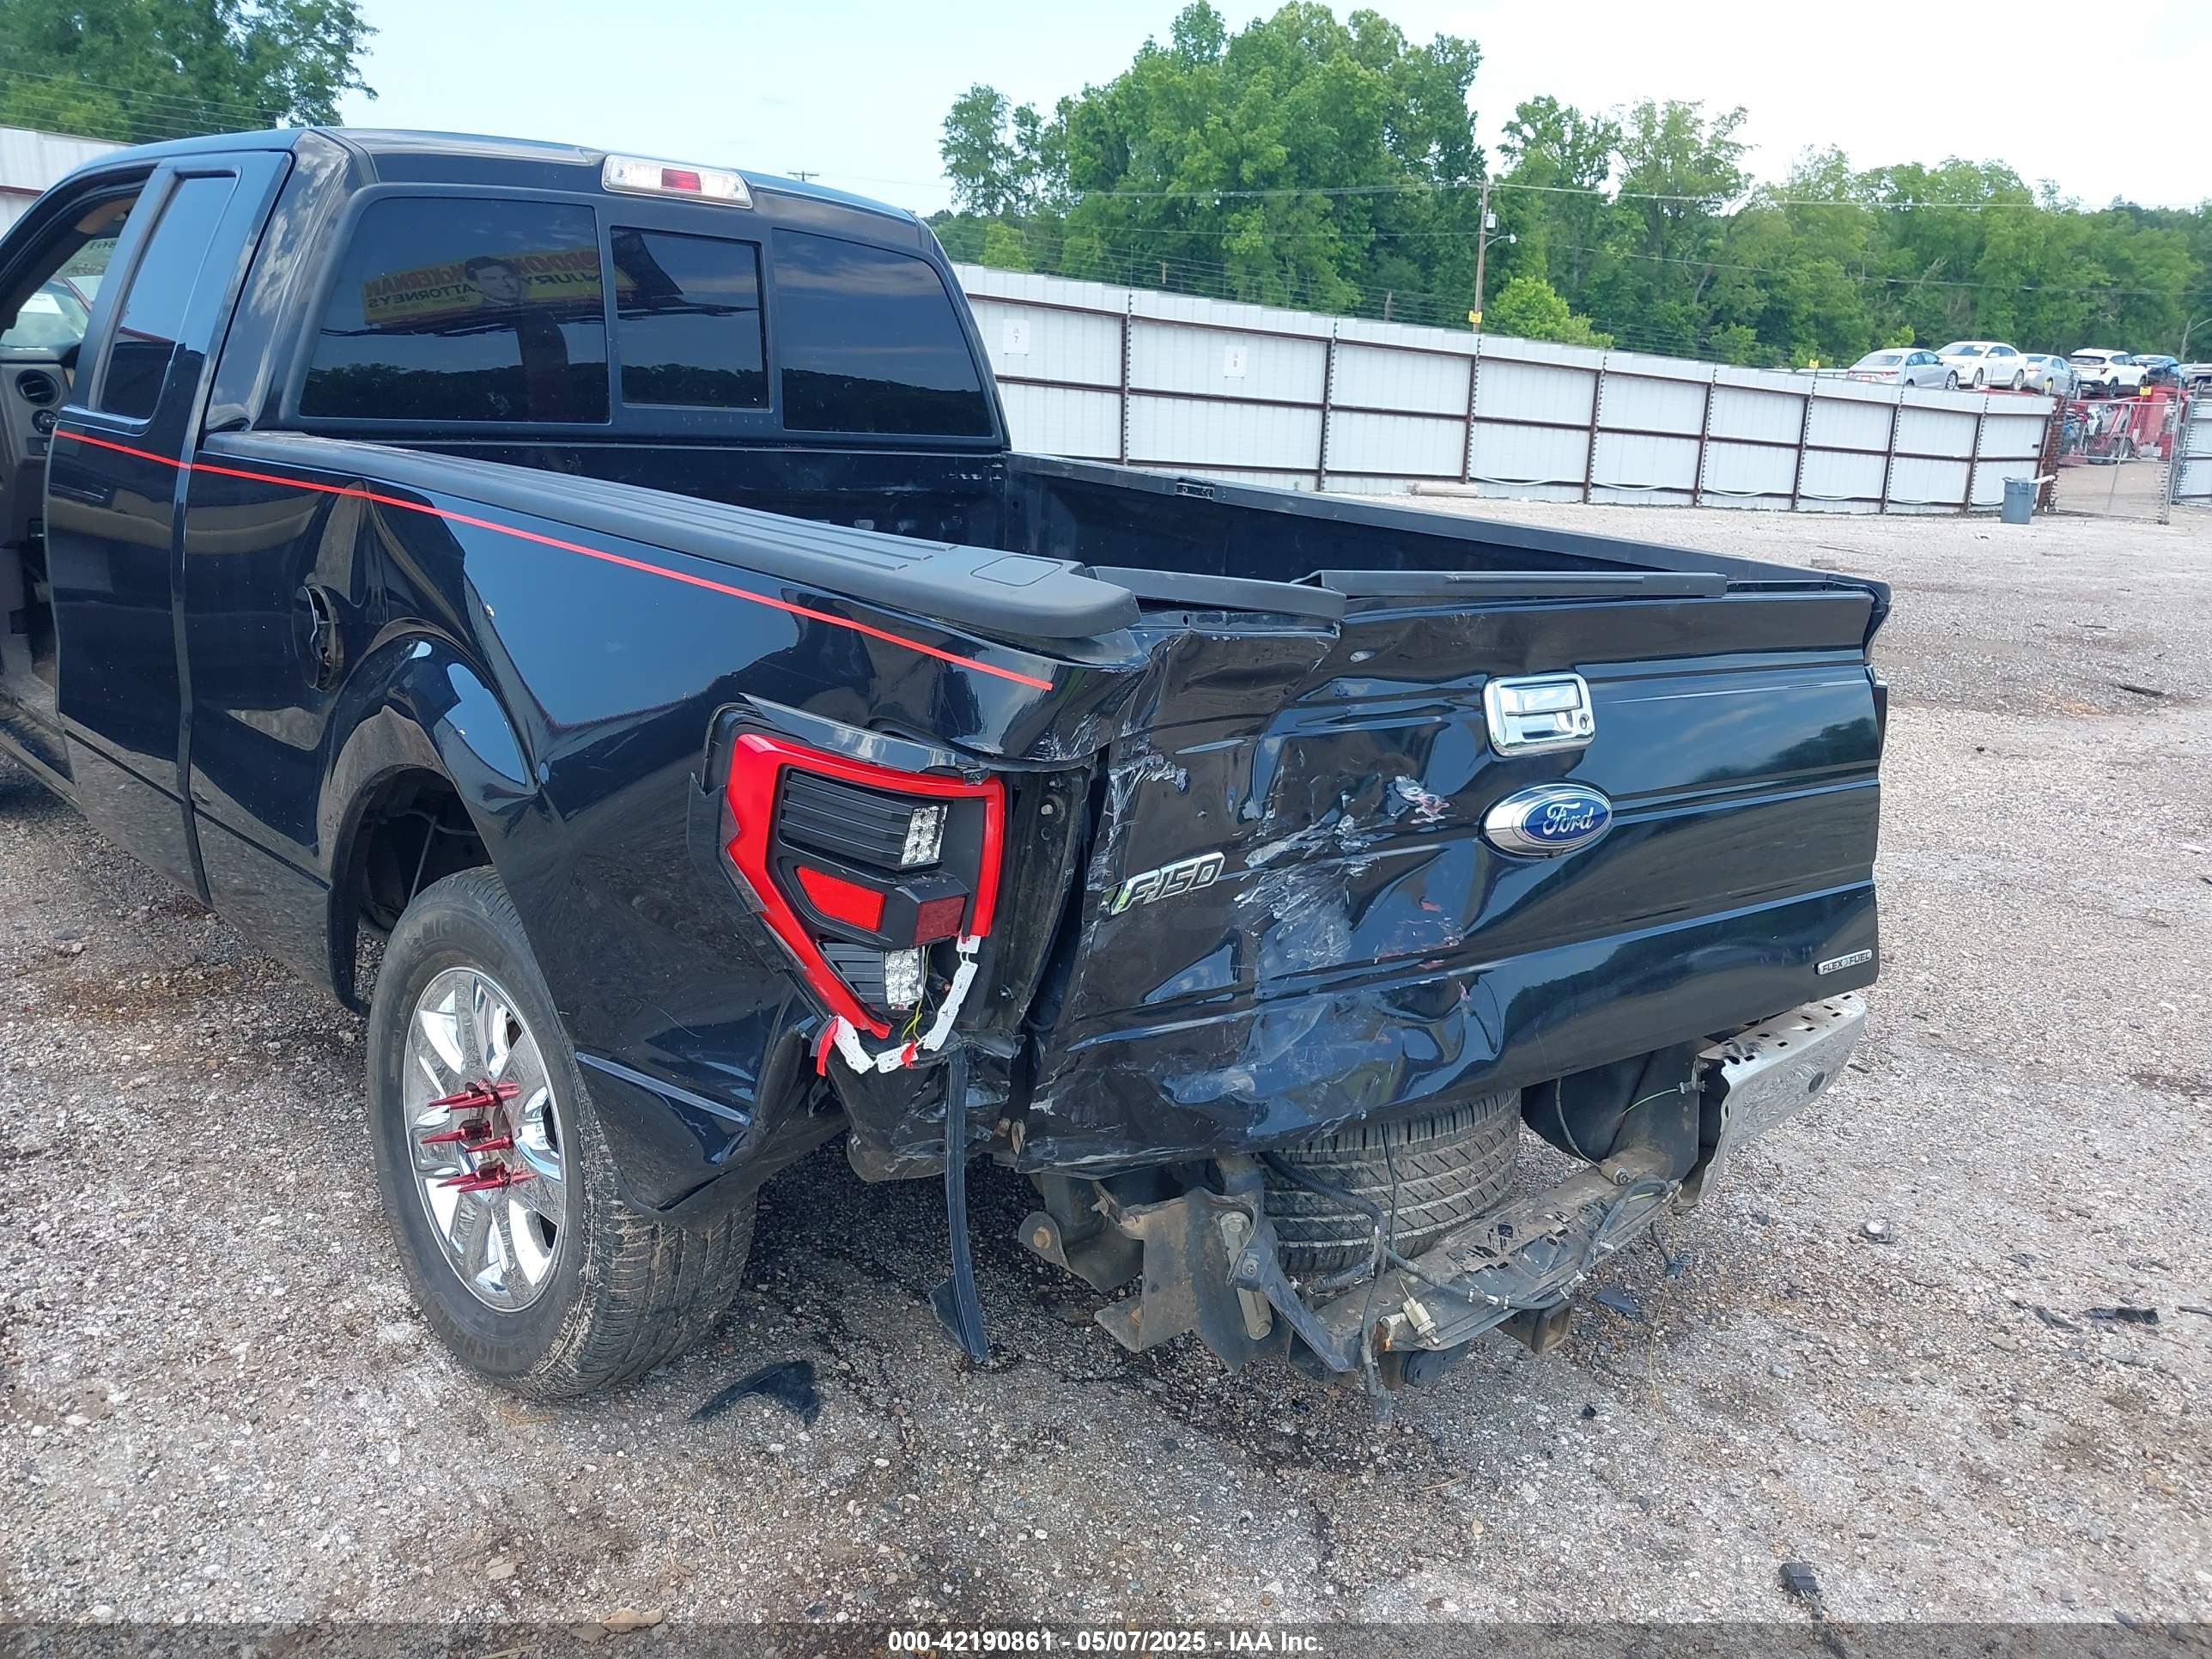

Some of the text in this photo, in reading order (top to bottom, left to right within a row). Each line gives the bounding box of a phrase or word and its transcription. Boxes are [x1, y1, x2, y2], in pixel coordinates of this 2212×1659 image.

[1543, 802, 1595, 835] Ford
[1821, 951, 1871, 973] FLEX FUEL
